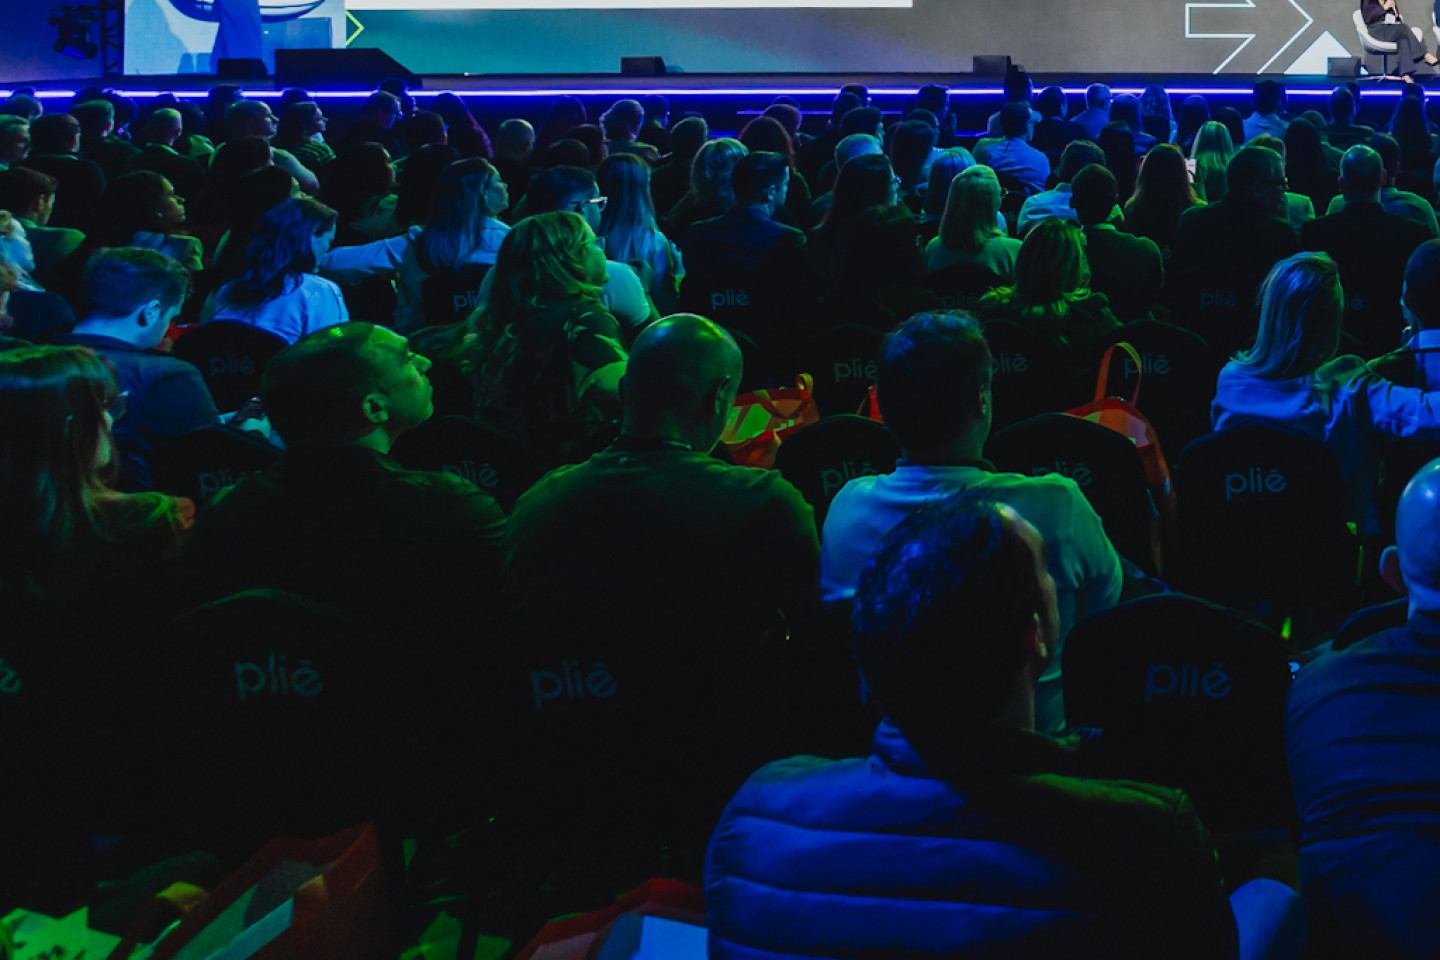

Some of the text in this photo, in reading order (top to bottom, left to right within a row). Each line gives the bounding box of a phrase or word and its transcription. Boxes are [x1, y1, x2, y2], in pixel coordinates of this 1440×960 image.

[1225, 465, 1287, 499] plié
[234, 651, 325, 701] plié
[530, 659, 619, 710] plié
